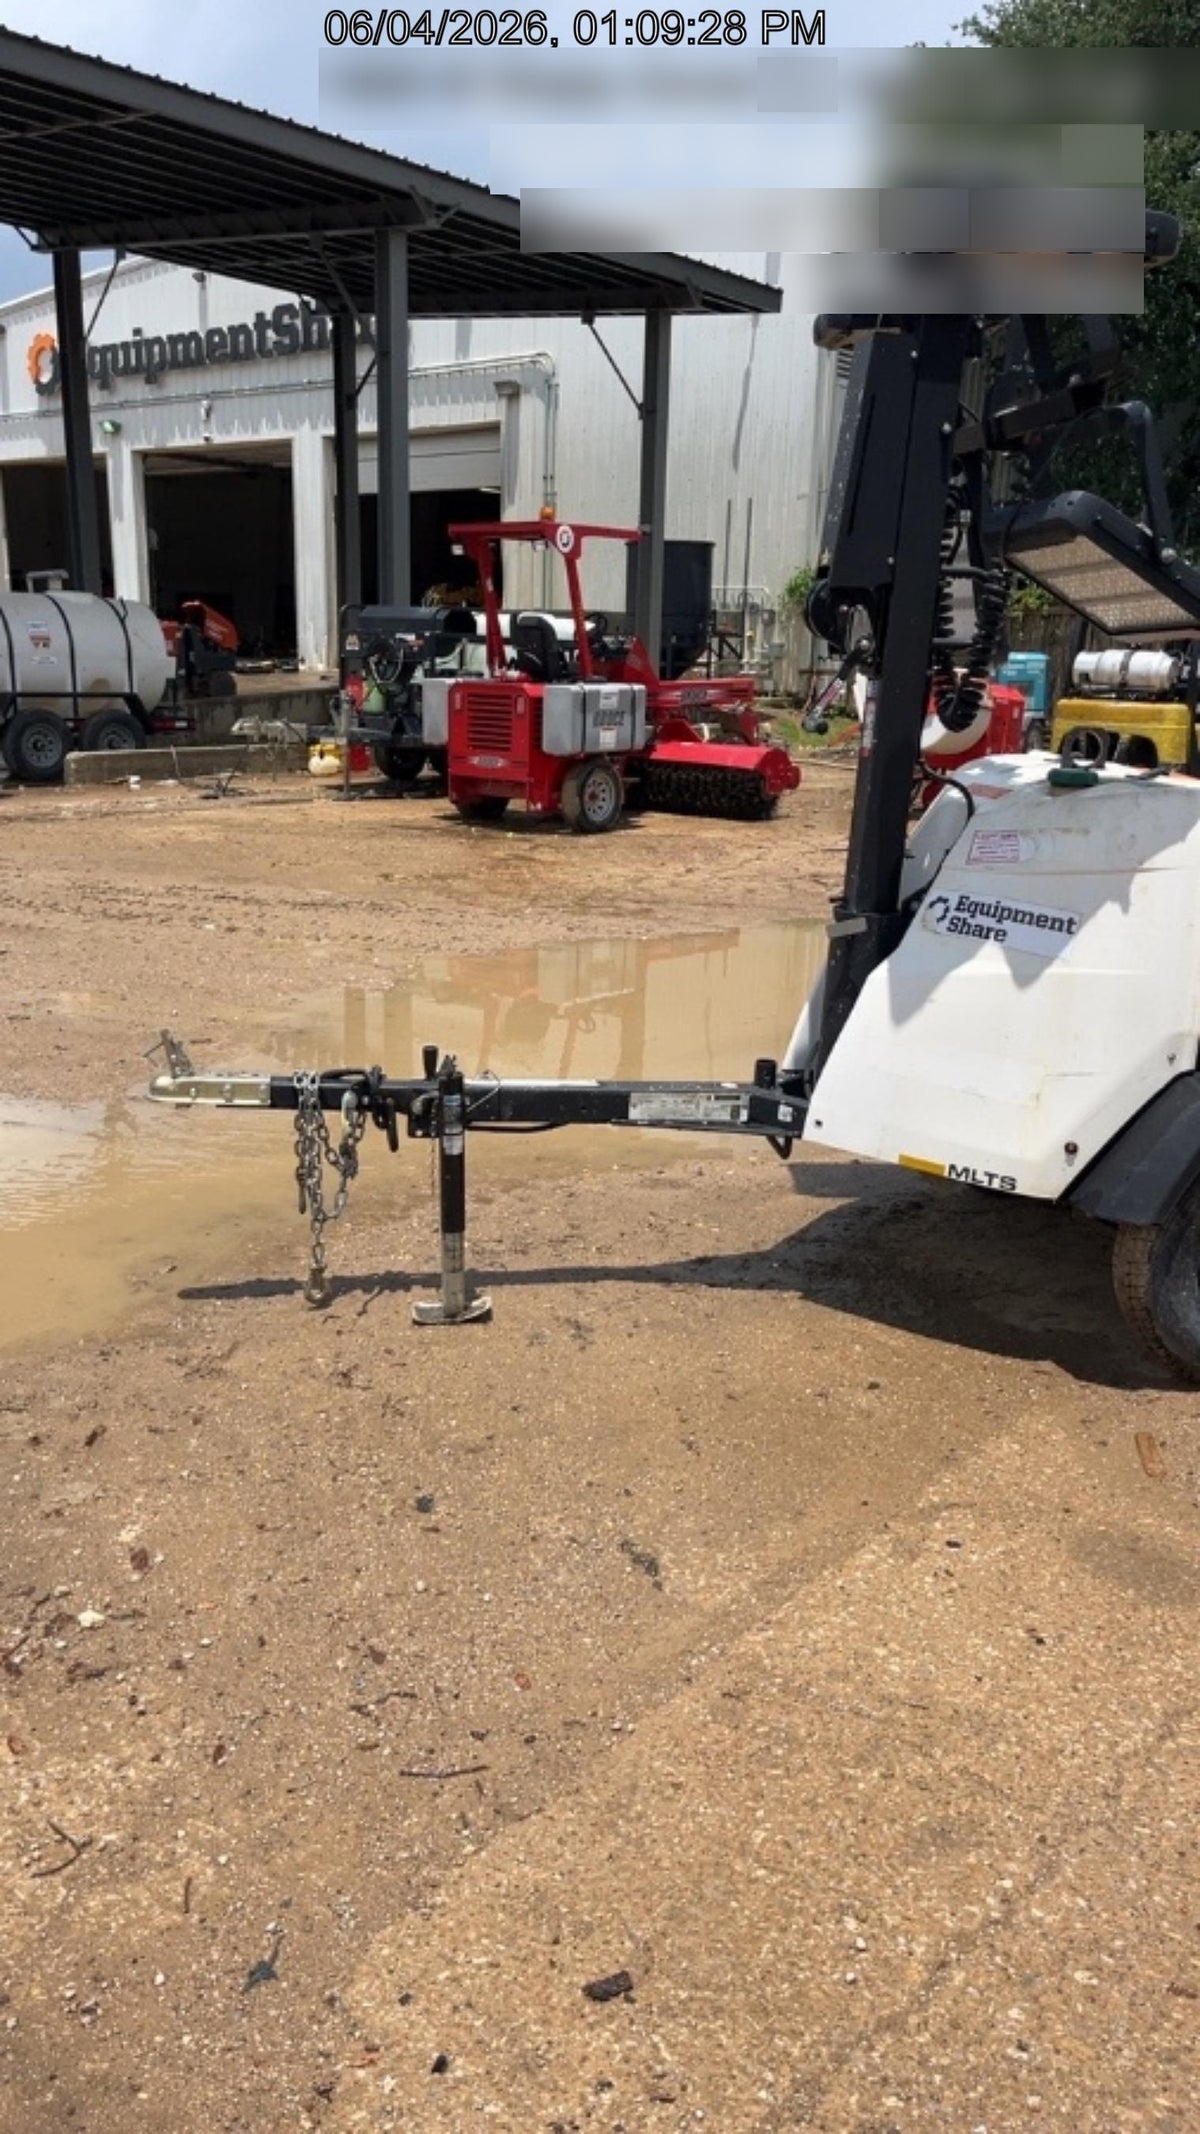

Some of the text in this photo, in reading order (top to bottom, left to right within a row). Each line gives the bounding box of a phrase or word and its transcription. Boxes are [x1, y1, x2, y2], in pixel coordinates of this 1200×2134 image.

[87, 301, 378, 390] quipmentShr
[945, 915, 1008, 942] Share
[953, 895, 1078, 935] Equipment
[947, 1163, 1018, 1192] MLTS
